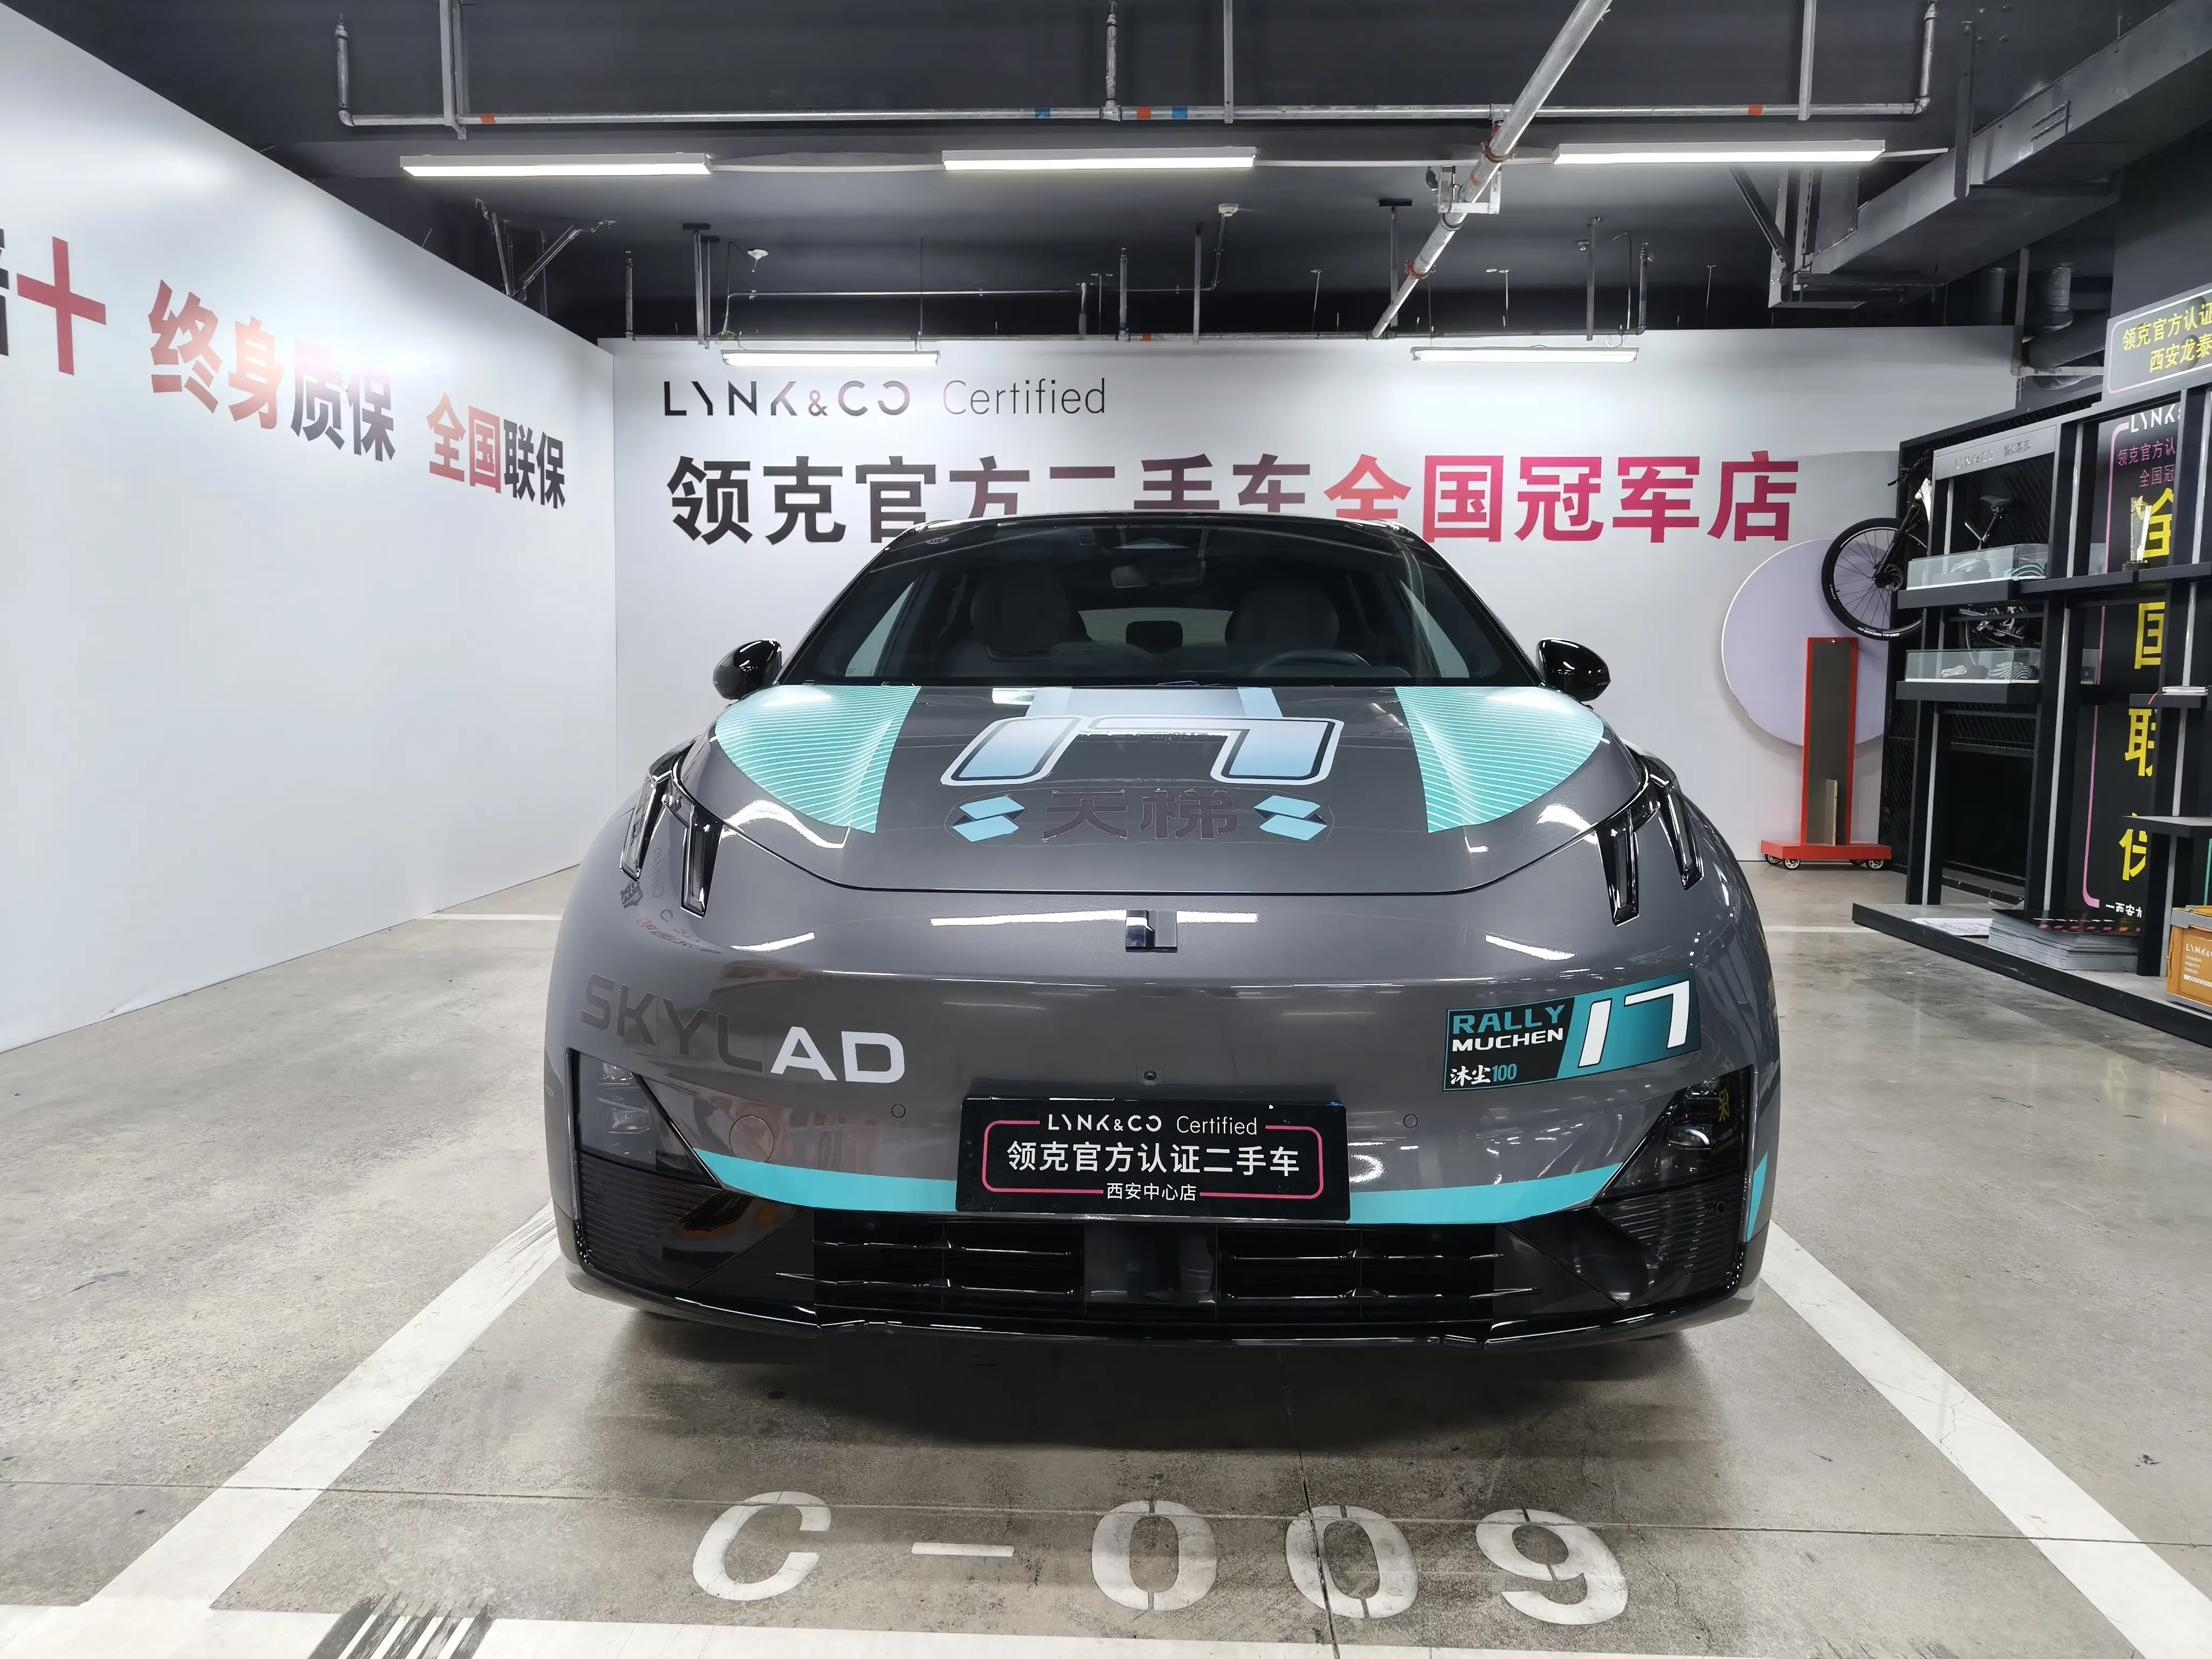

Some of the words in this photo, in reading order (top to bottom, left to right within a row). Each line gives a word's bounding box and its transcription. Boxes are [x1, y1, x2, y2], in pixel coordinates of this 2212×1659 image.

[2122, 301, 2212, 351] 领克官方认证
[2149, 333, 2212, 373] 西安龙泰
[148, 279, 395, 462] 终身质保
[426, 392, 566, 509] 全国联保
[664, 380, 910, 416] LYNK&CO
[943, 377, 1105, 415] Certified
[2117, 437, 2176, 466] 领克官方认
[1042, 788, 1239, 840] 天梯
[1453, 1004, 1565, 1035] RALLY
[1577, 980, 1690, 1069] 17
[1452, 1027, 1563, 1052] MUCHEN
[1048, 1114, 1162, 1133] LYNK&CO
[1176, 1115, 1258, 1135] Certified
[1007, 1141, 1299, 1177] 领克官方认证二手车
[1107, 1182, 1197, 1202] 西安中心店
